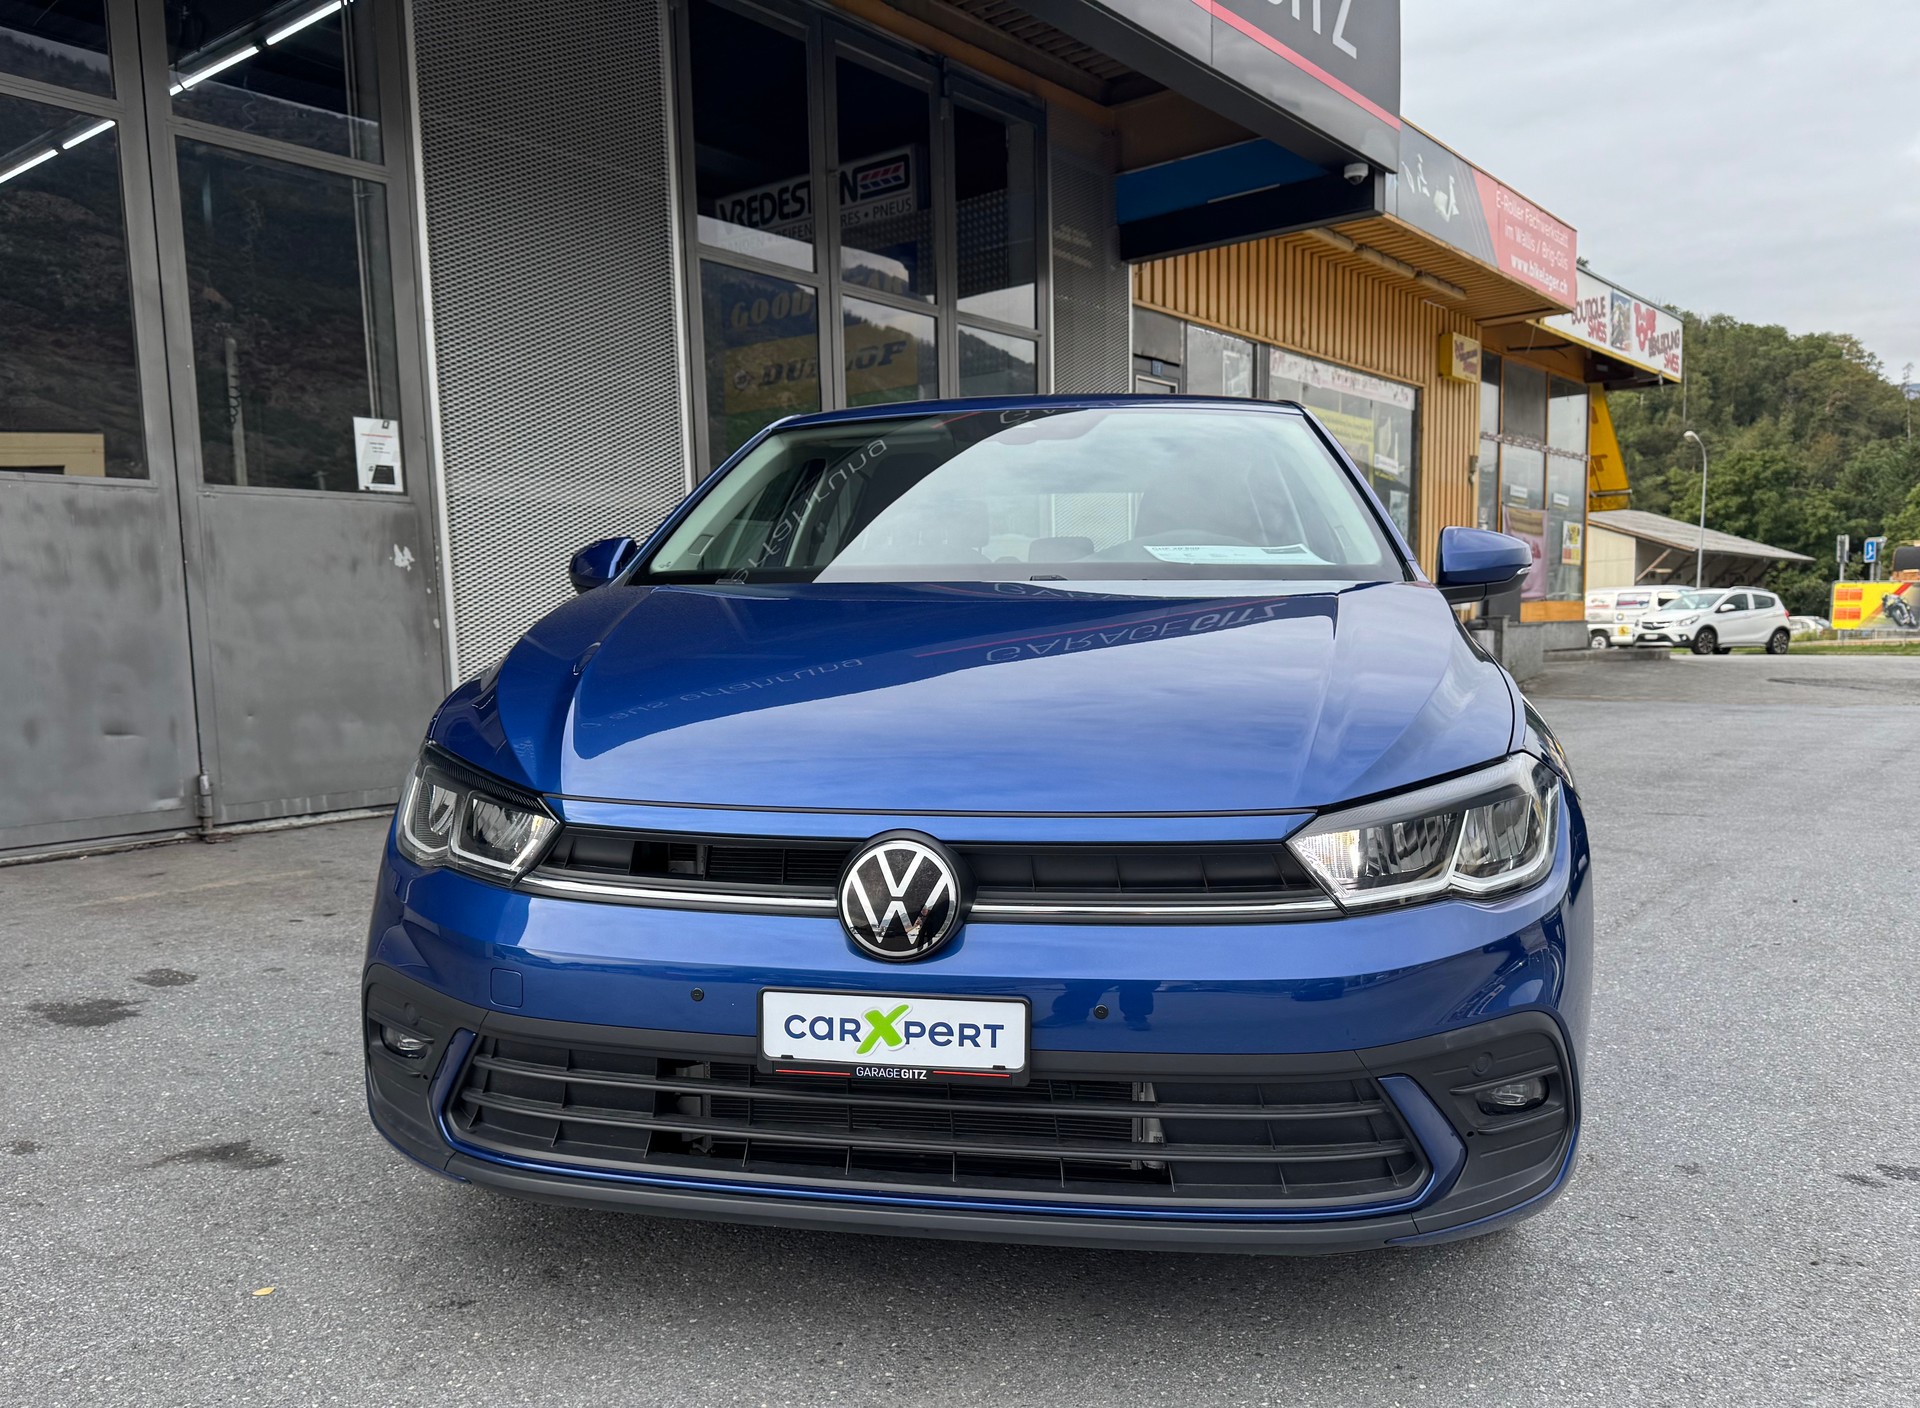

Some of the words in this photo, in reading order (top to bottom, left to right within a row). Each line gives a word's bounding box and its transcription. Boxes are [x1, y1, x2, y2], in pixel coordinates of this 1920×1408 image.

[872, 197, 912, 219] PNEUS
[1504, 220, 1514, 241] im
[1515, 227, 1536, 253] Wallis
